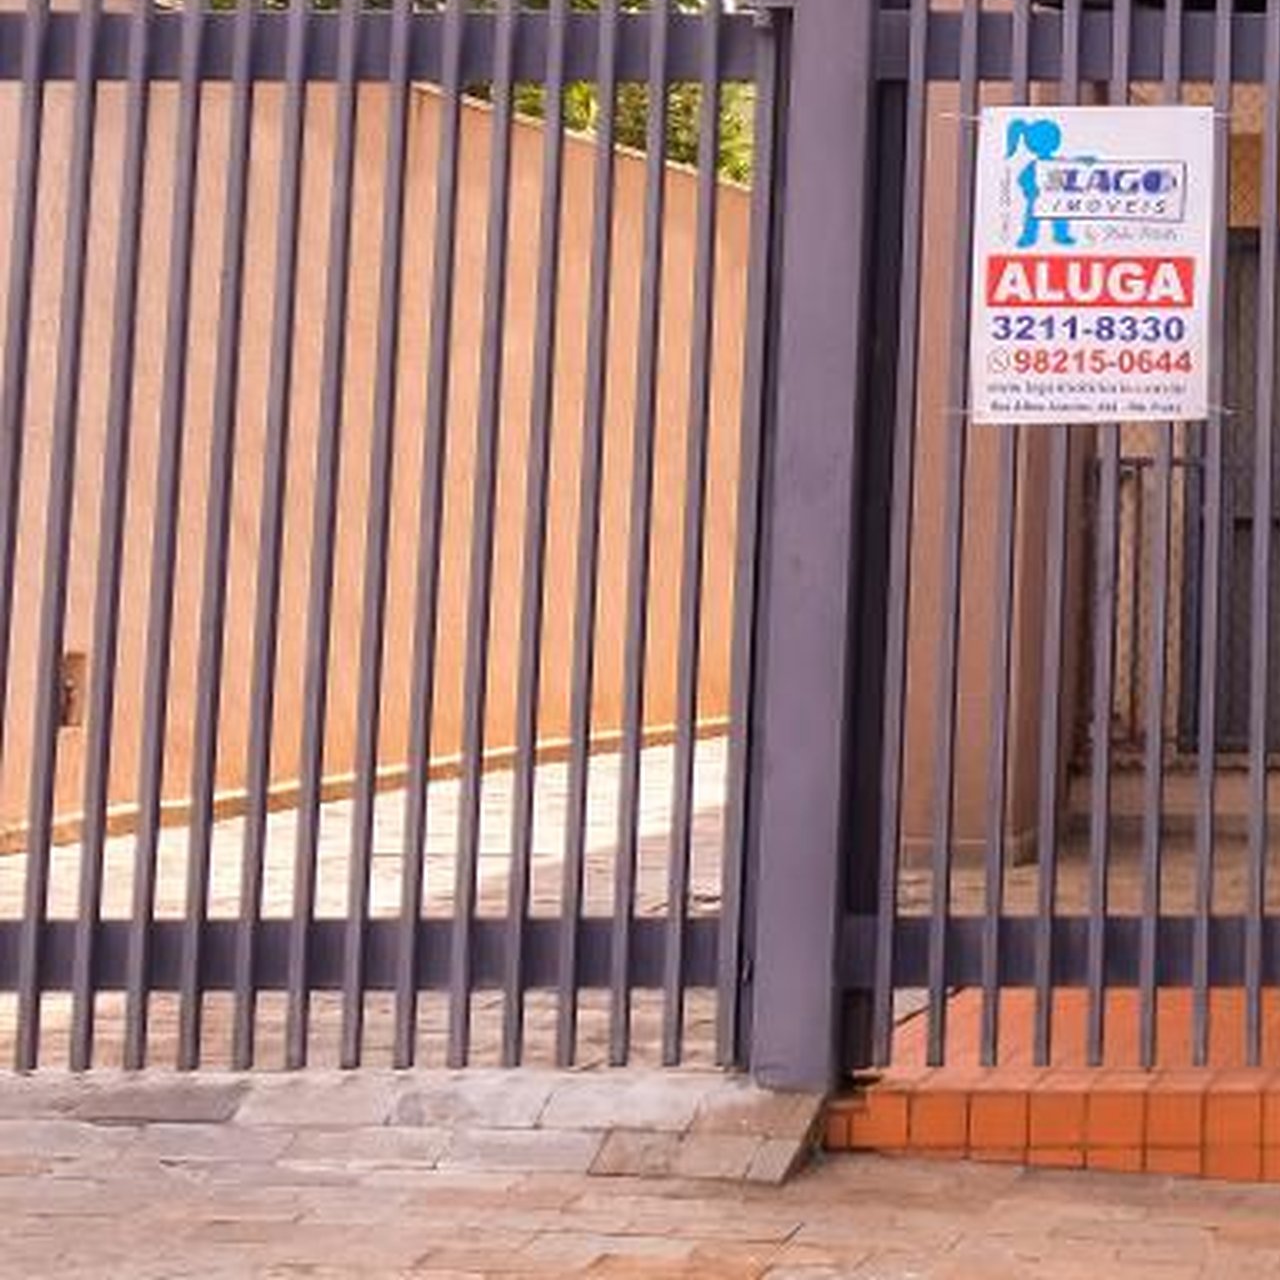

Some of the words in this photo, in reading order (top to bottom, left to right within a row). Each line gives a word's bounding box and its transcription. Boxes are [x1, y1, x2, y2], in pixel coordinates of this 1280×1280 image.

[991, 261, 1187, 302] ALUGA
[991, 314, 1186, 342] 3211-8330
[1013, 348, 1193, 374] 98215-0644
